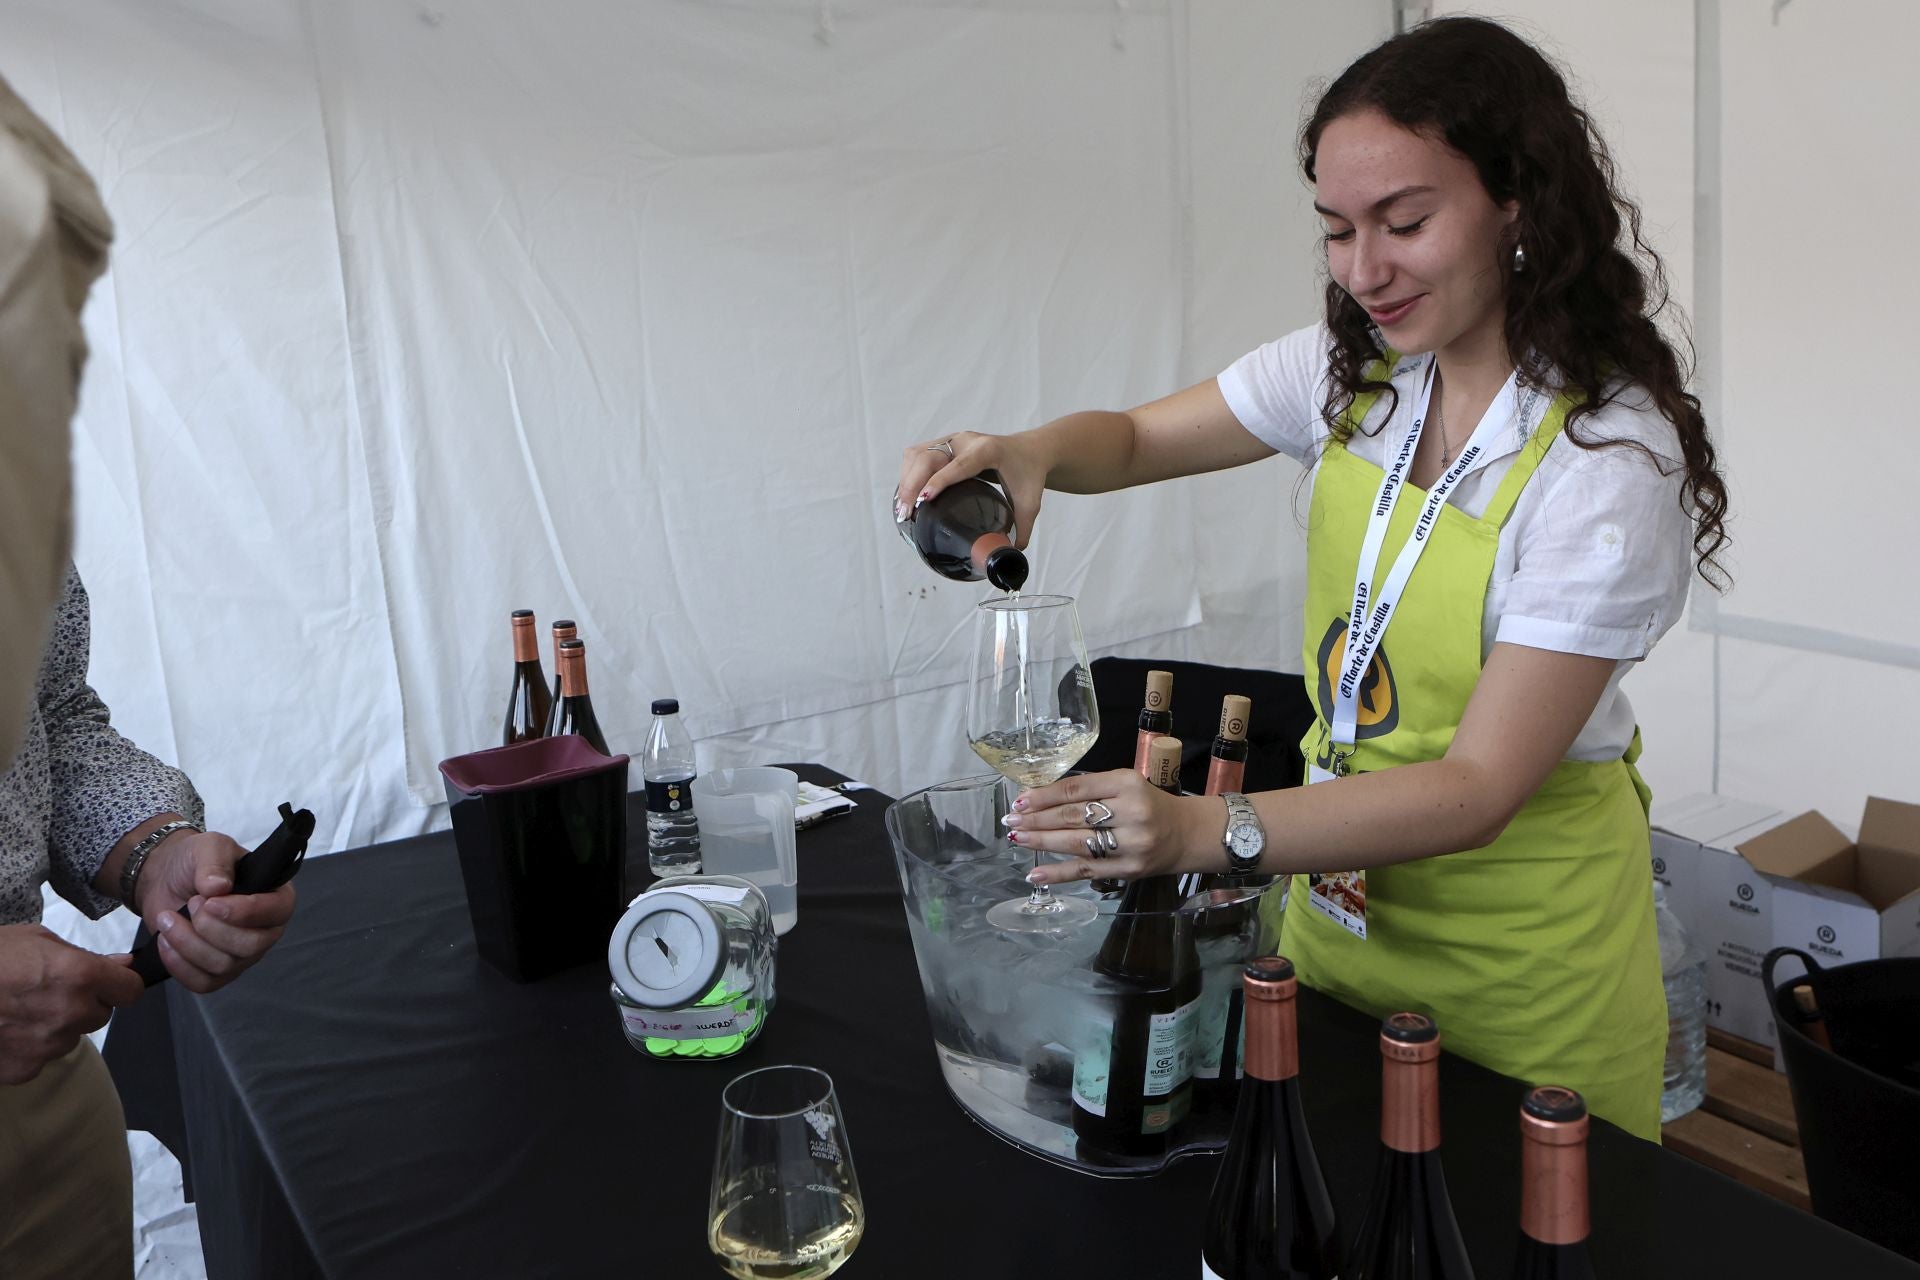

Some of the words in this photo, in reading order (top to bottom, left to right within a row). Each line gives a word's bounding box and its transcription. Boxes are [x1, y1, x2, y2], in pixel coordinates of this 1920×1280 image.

[1411, 419, 1422, 433] El
[1398, 433, 1416, 462] Norte
[1392, 461, 1406, 474] de
[1445, 445, 1481, 484] Castilla
[1376, 473, 1400, 517] Castilla
[1434, 482, 1449, 496] de
[1421, 494, 1441, 526] Norte
[1415, 524, 1428, 541] El
[1357, 581, 1368, 598] El
[1352, 599, 1366, 630] Norte
[1363, 601, 1391, 645] Castilla
[1355, 643, 1370, 657] de
[1342, 655, 1365, 685] Norte
[1340, 682, 1353, 699] El
[1160, 758, 1170, 785] RUED
[1808, 941, 1844, 958] RUEDA
